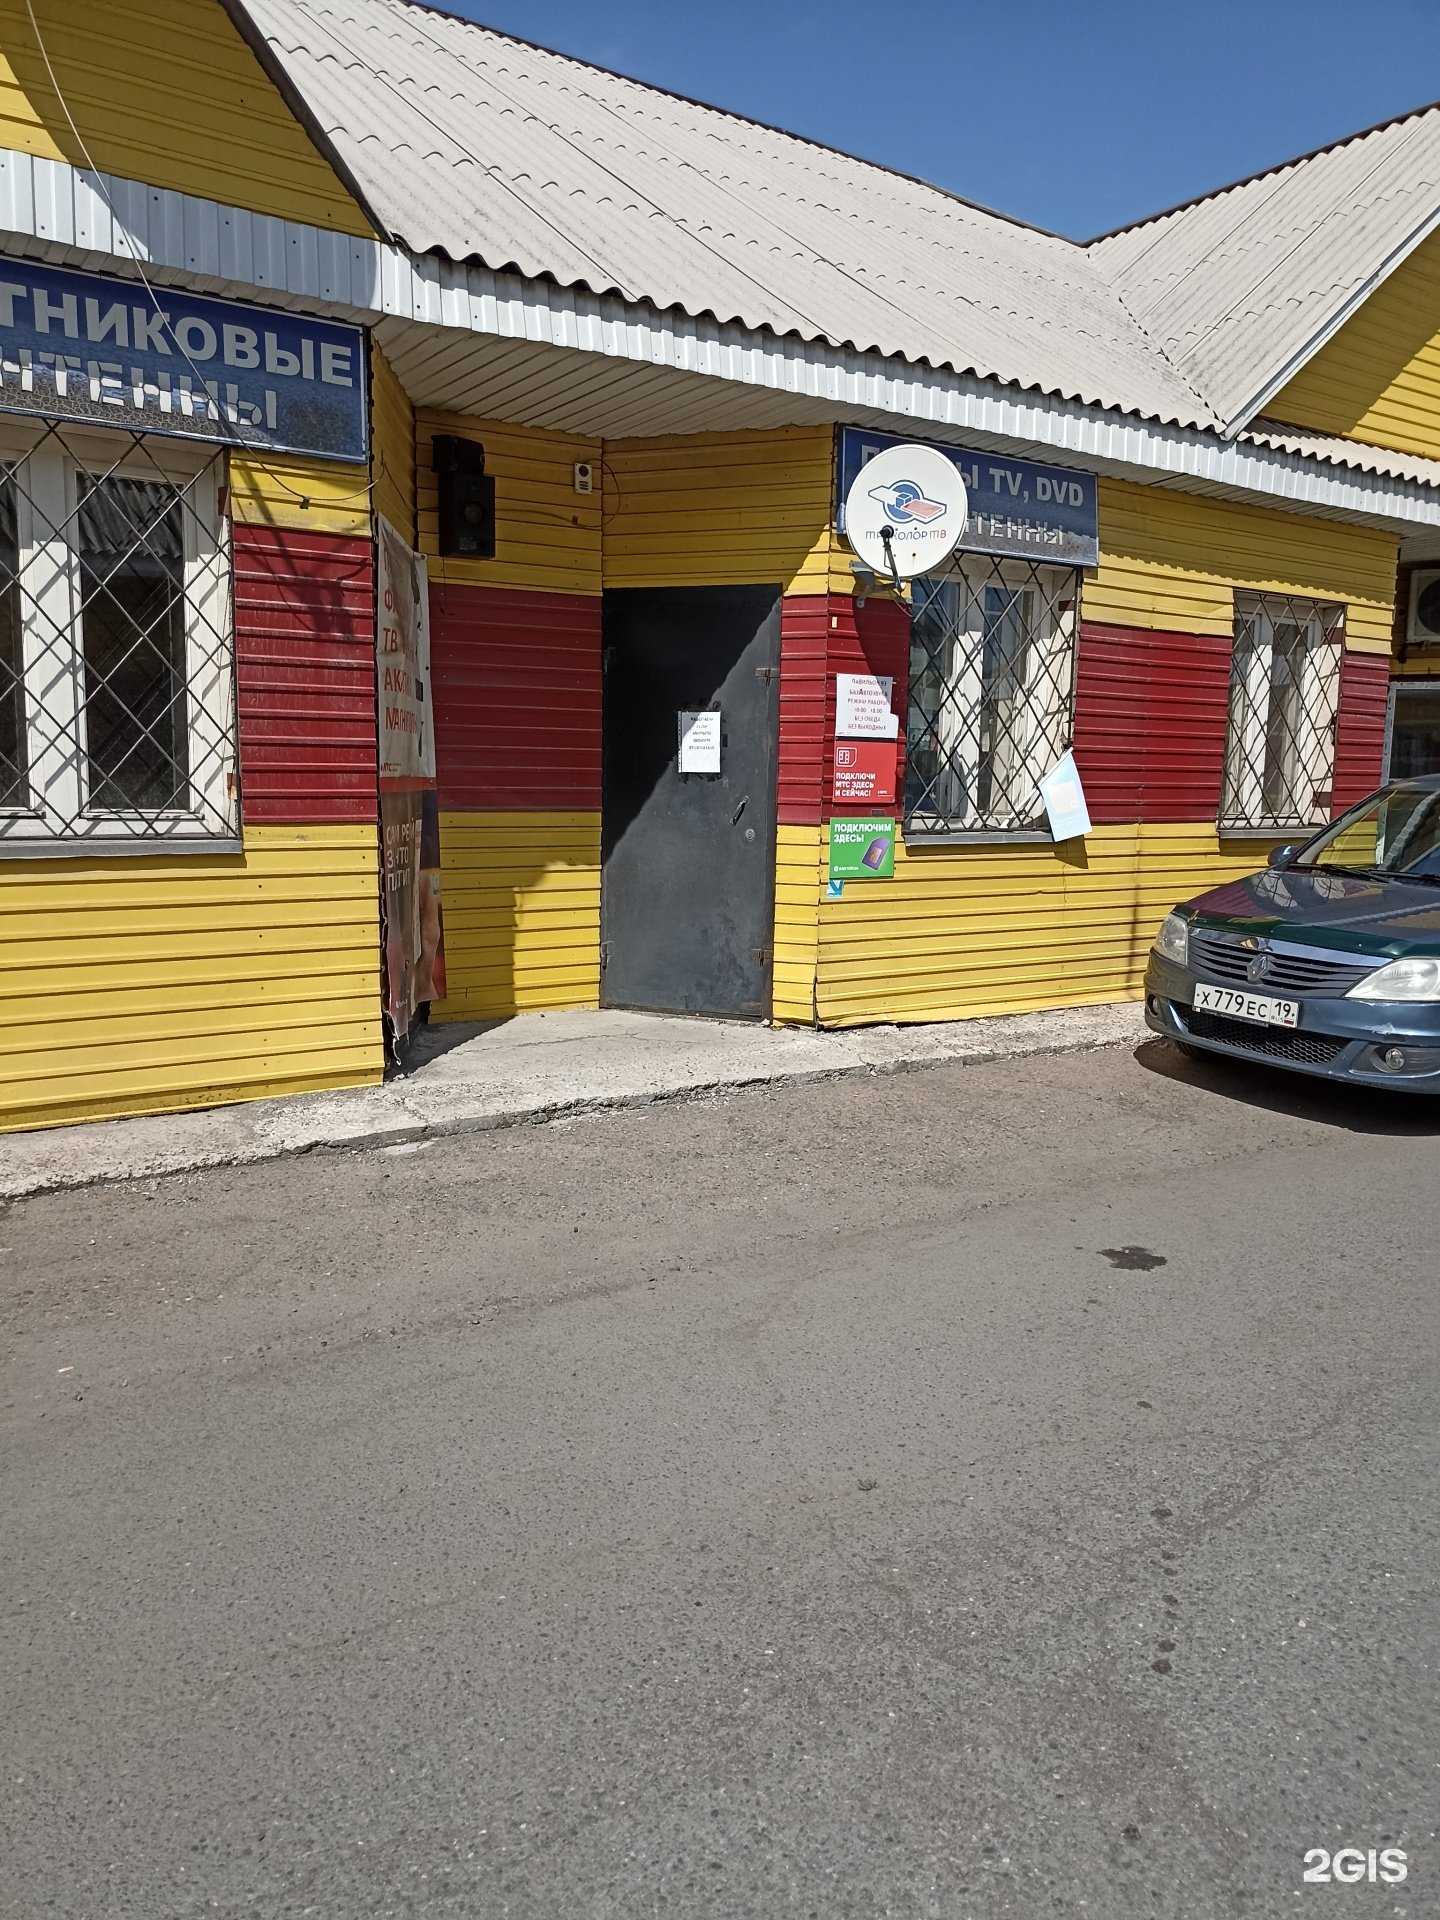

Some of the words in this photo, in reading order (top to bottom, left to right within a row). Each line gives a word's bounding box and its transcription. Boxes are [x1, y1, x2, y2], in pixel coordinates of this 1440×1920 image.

[1036, 476, 1084, 507] DVD
[835, 772, 876, 781] ПОДКЛЮЧИ
[851, 781, 875, 790] ЗДЕСЬ
[834, 789, 841, 797] И
[841, 789, 871, 797] СЕЙЧАС!
[834, 823, 892, 833] ПОДКЛЮЧИМ
[1274, 1001, 1292, 1018] 19
